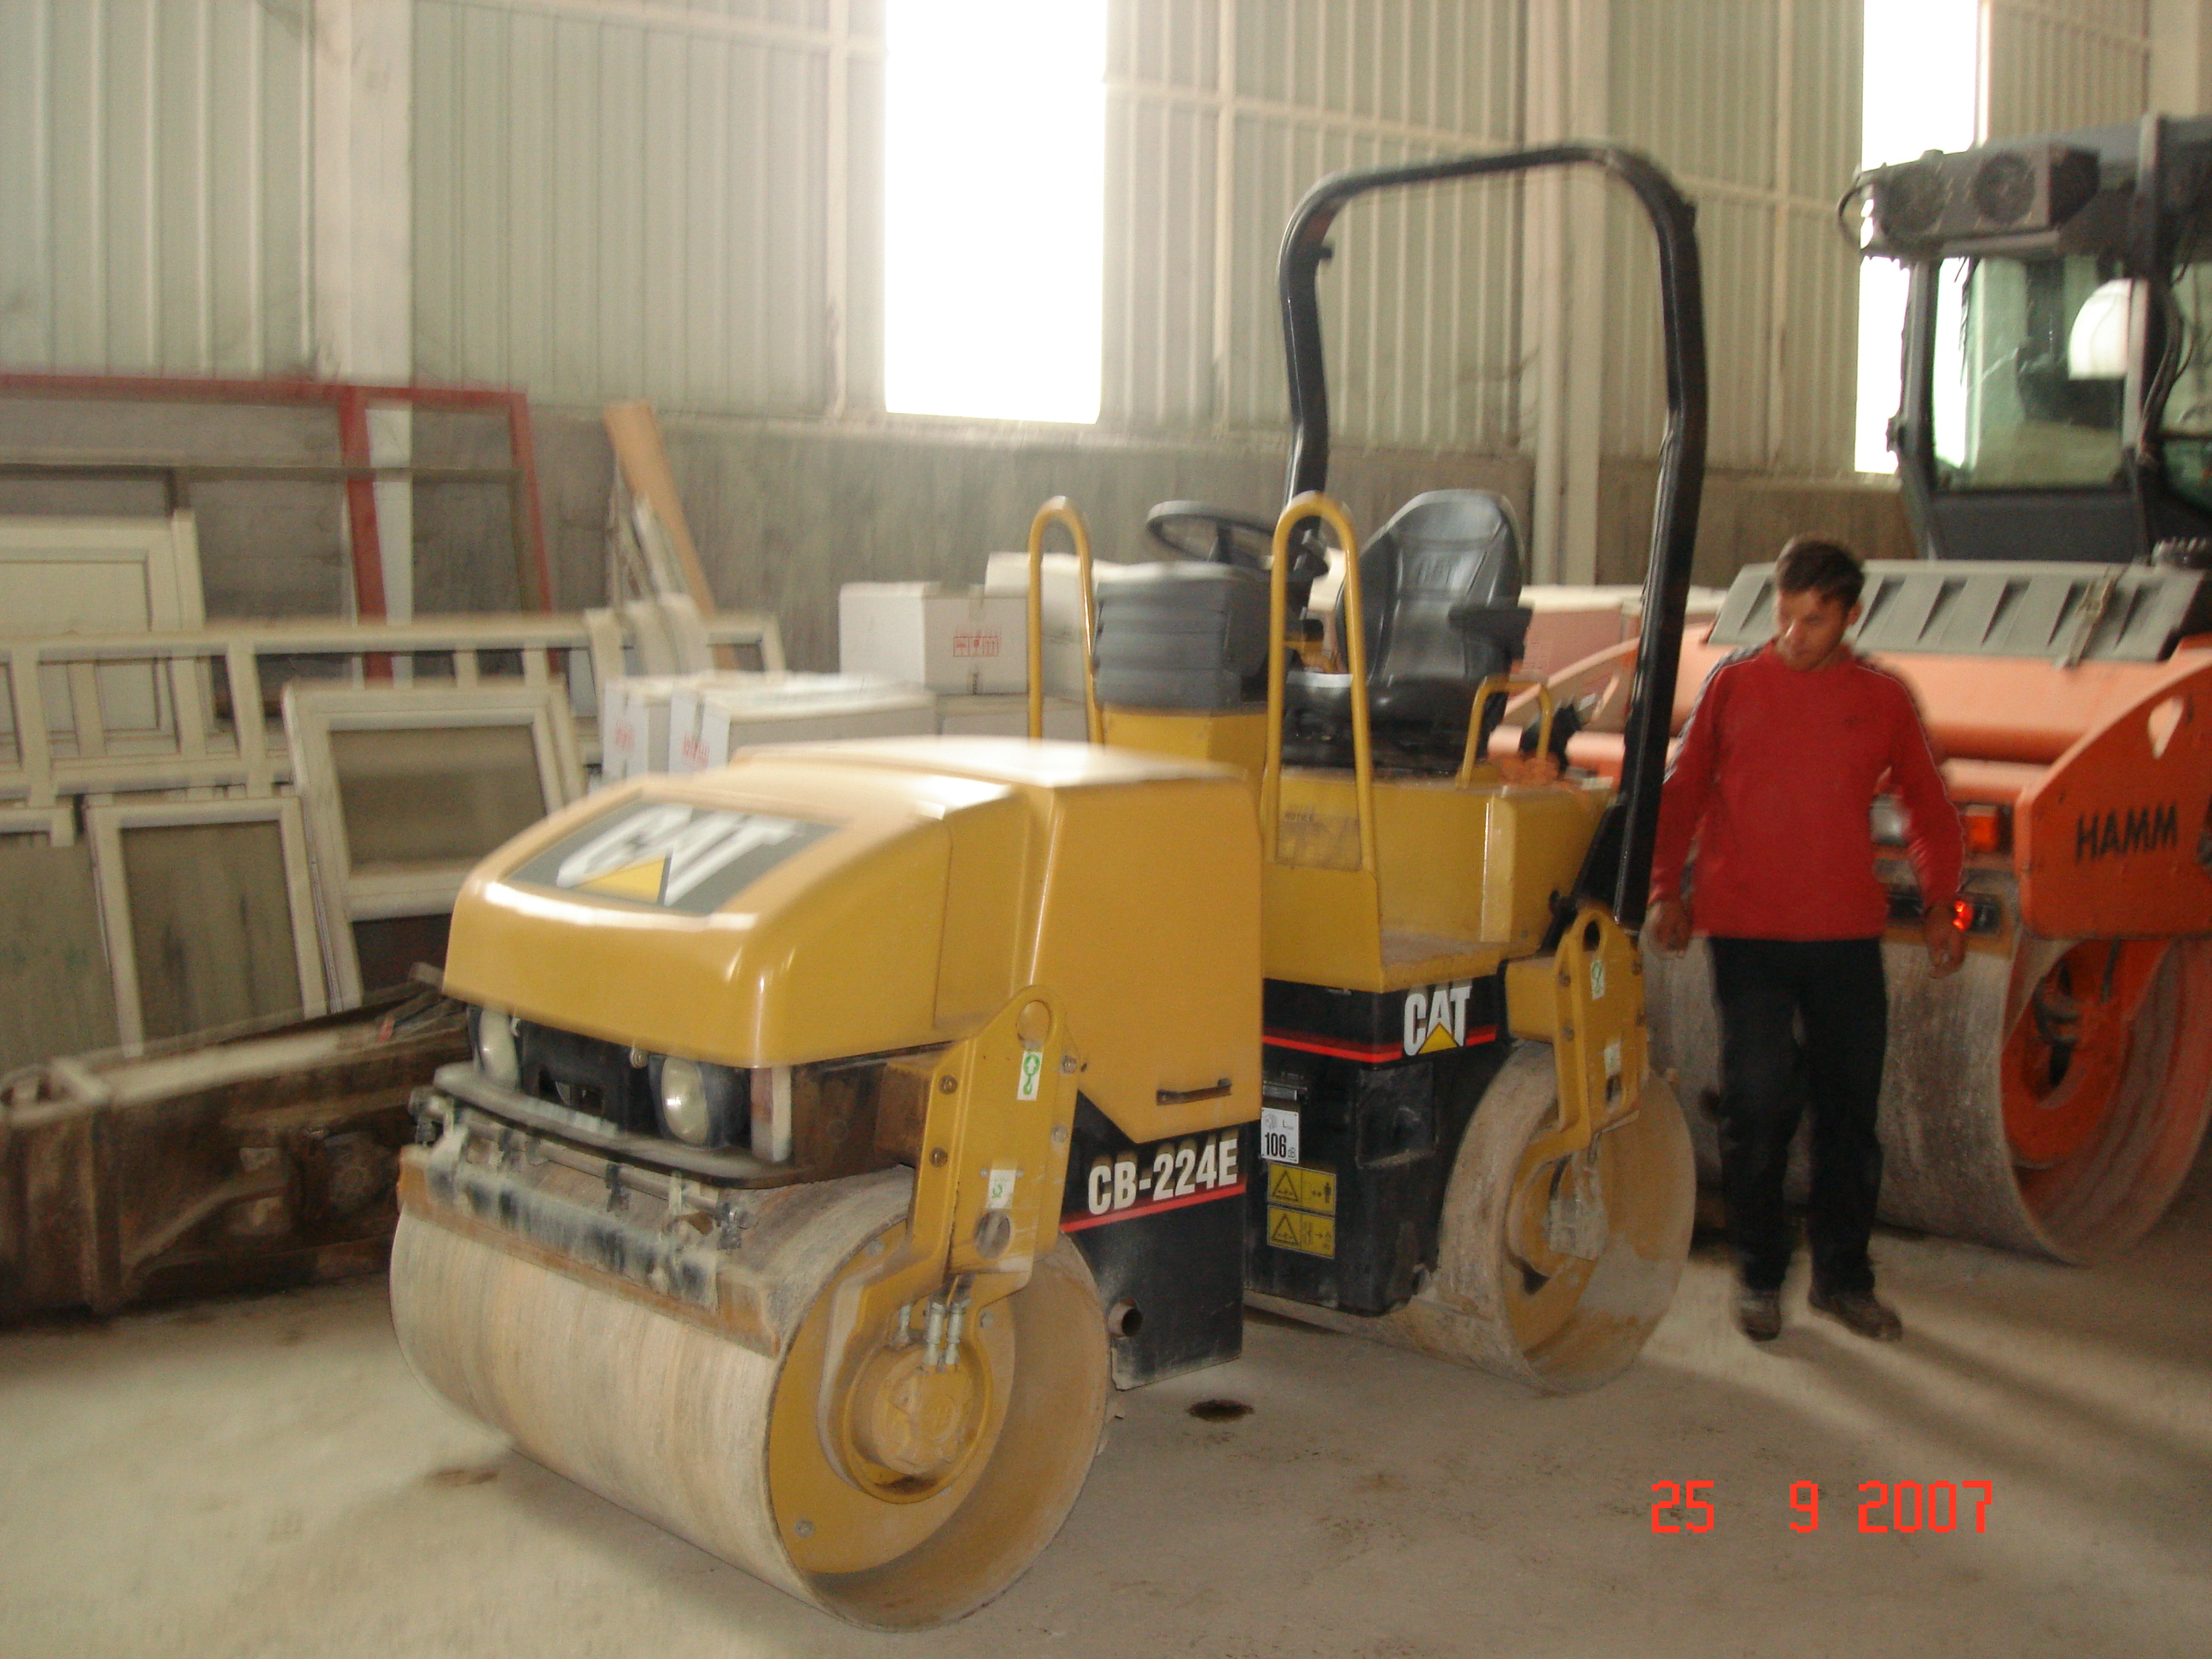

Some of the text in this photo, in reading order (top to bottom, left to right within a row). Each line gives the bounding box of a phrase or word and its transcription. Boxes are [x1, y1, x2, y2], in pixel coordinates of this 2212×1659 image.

[556, 804, 797, 907] CAT
[2075, 803, 2178, 865] HAMM
[1403, 986, 1472, 1057] CAT
[1088, 1138, 1237, 1215] CB-224E
[1265, 1132, 1287, 1158] 106
